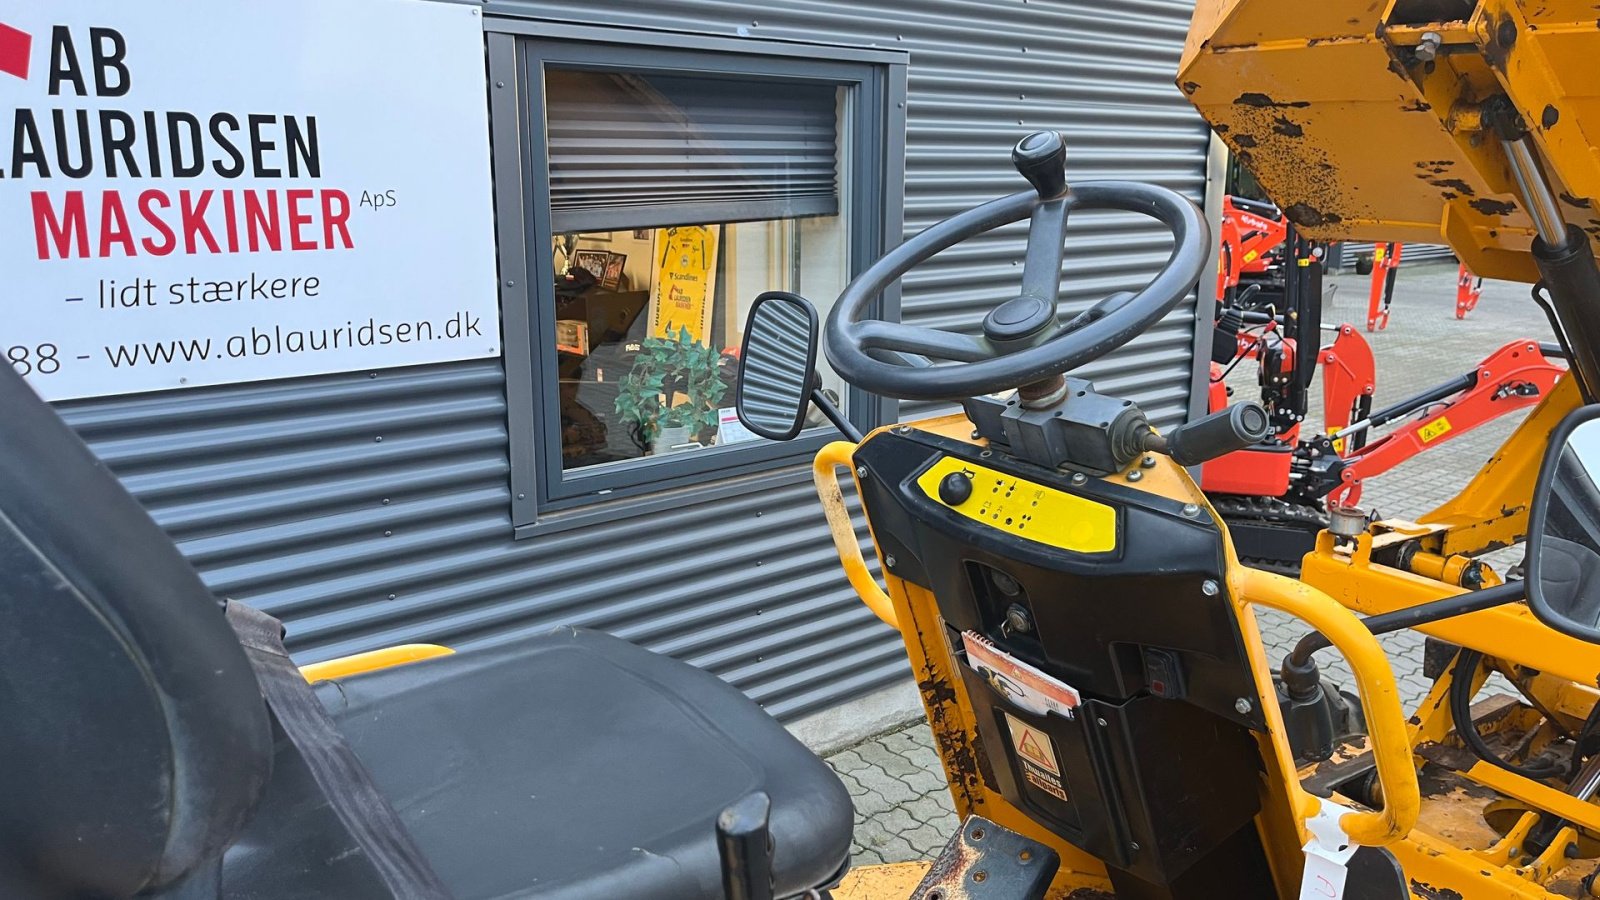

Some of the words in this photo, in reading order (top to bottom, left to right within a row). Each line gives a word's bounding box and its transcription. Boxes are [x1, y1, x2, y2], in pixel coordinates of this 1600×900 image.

[48, 25, 131, 97] AB
[0, 108, 321, 178] AURIDSEN
[31, 189, 354, 260] MASKINER
[359, 190, 396, 211] ApS
[99, 278, 157, 309] lidt
[168, 272, 320, 305] stærkere
[8, 343, 60, 377] 88
[105, 311, 482, 368] www.ablauridsen.dk
